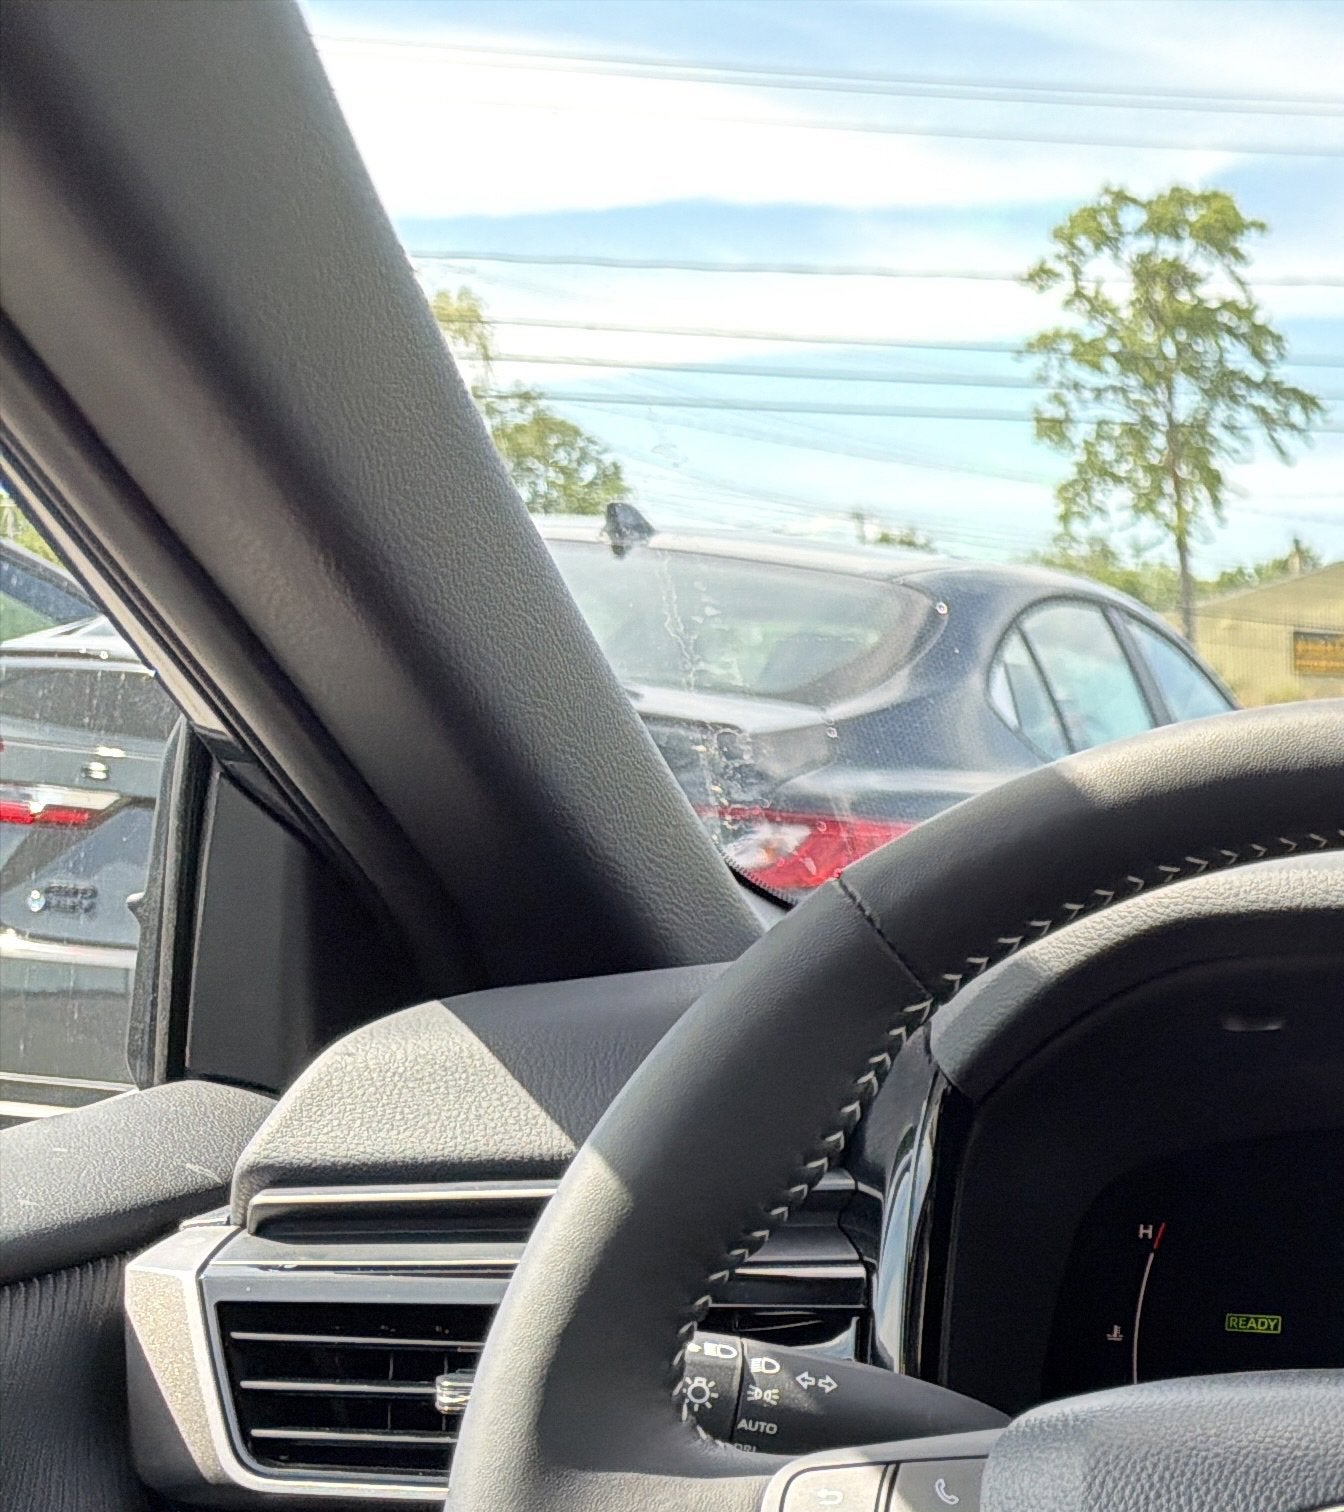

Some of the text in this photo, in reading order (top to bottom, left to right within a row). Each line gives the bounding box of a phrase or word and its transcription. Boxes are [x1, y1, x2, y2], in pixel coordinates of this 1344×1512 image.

[1138, 1223, 1153, 1240] H
[1228, 1316, 1279, 1331] READY
[736, 1418, 778, 1435] AUTO
